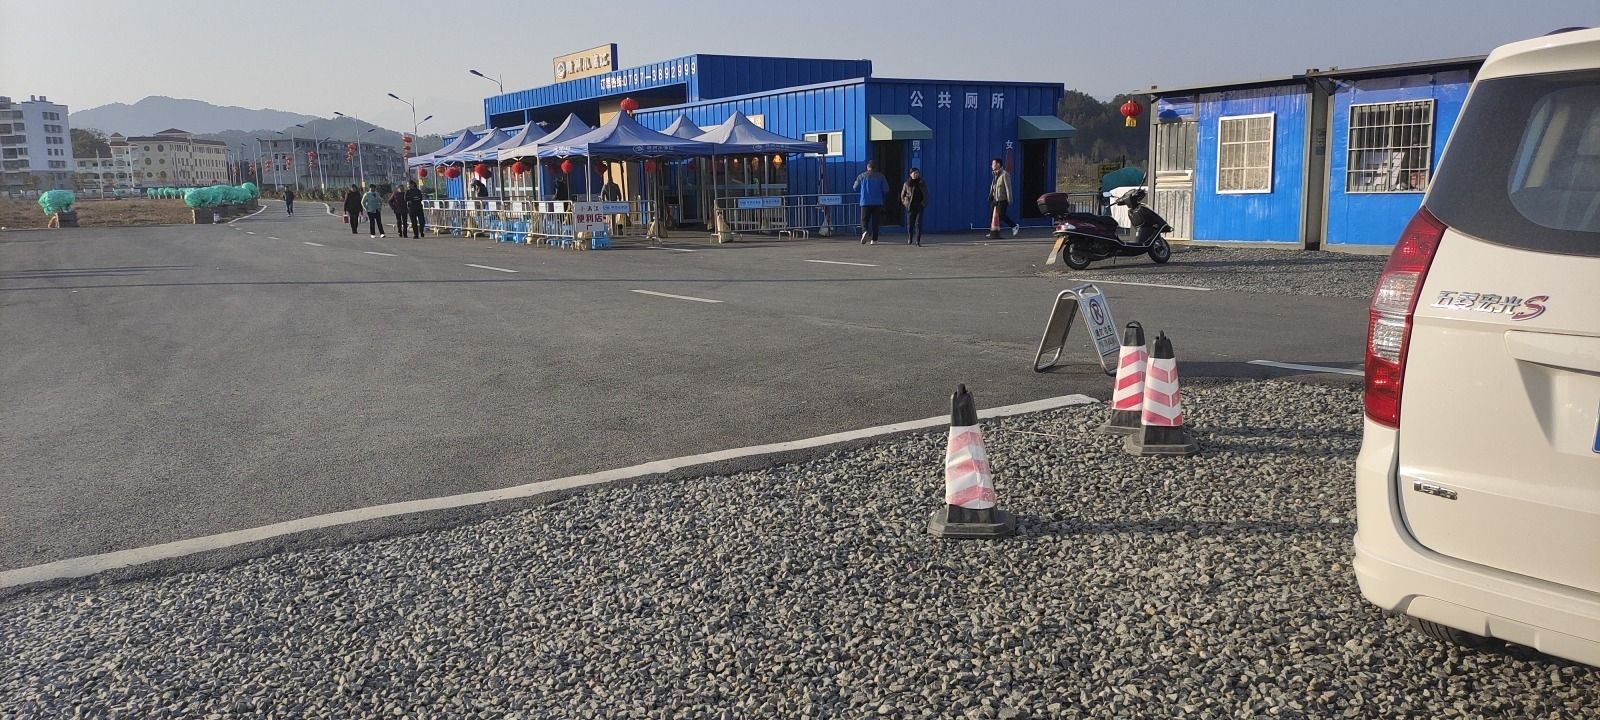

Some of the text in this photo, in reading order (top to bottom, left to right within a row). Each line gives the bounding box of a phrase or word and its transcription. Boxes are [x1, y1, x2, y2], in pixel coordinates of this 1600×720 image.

[910, 90, 1005, 109] 公共厕所
[912, 140, 921, 151] 男
[1005, 139, 1014, 150] 女
[576, 213, 603, 224] 便利店
[1431, 290, 1549, 321] 五菱宏光S
